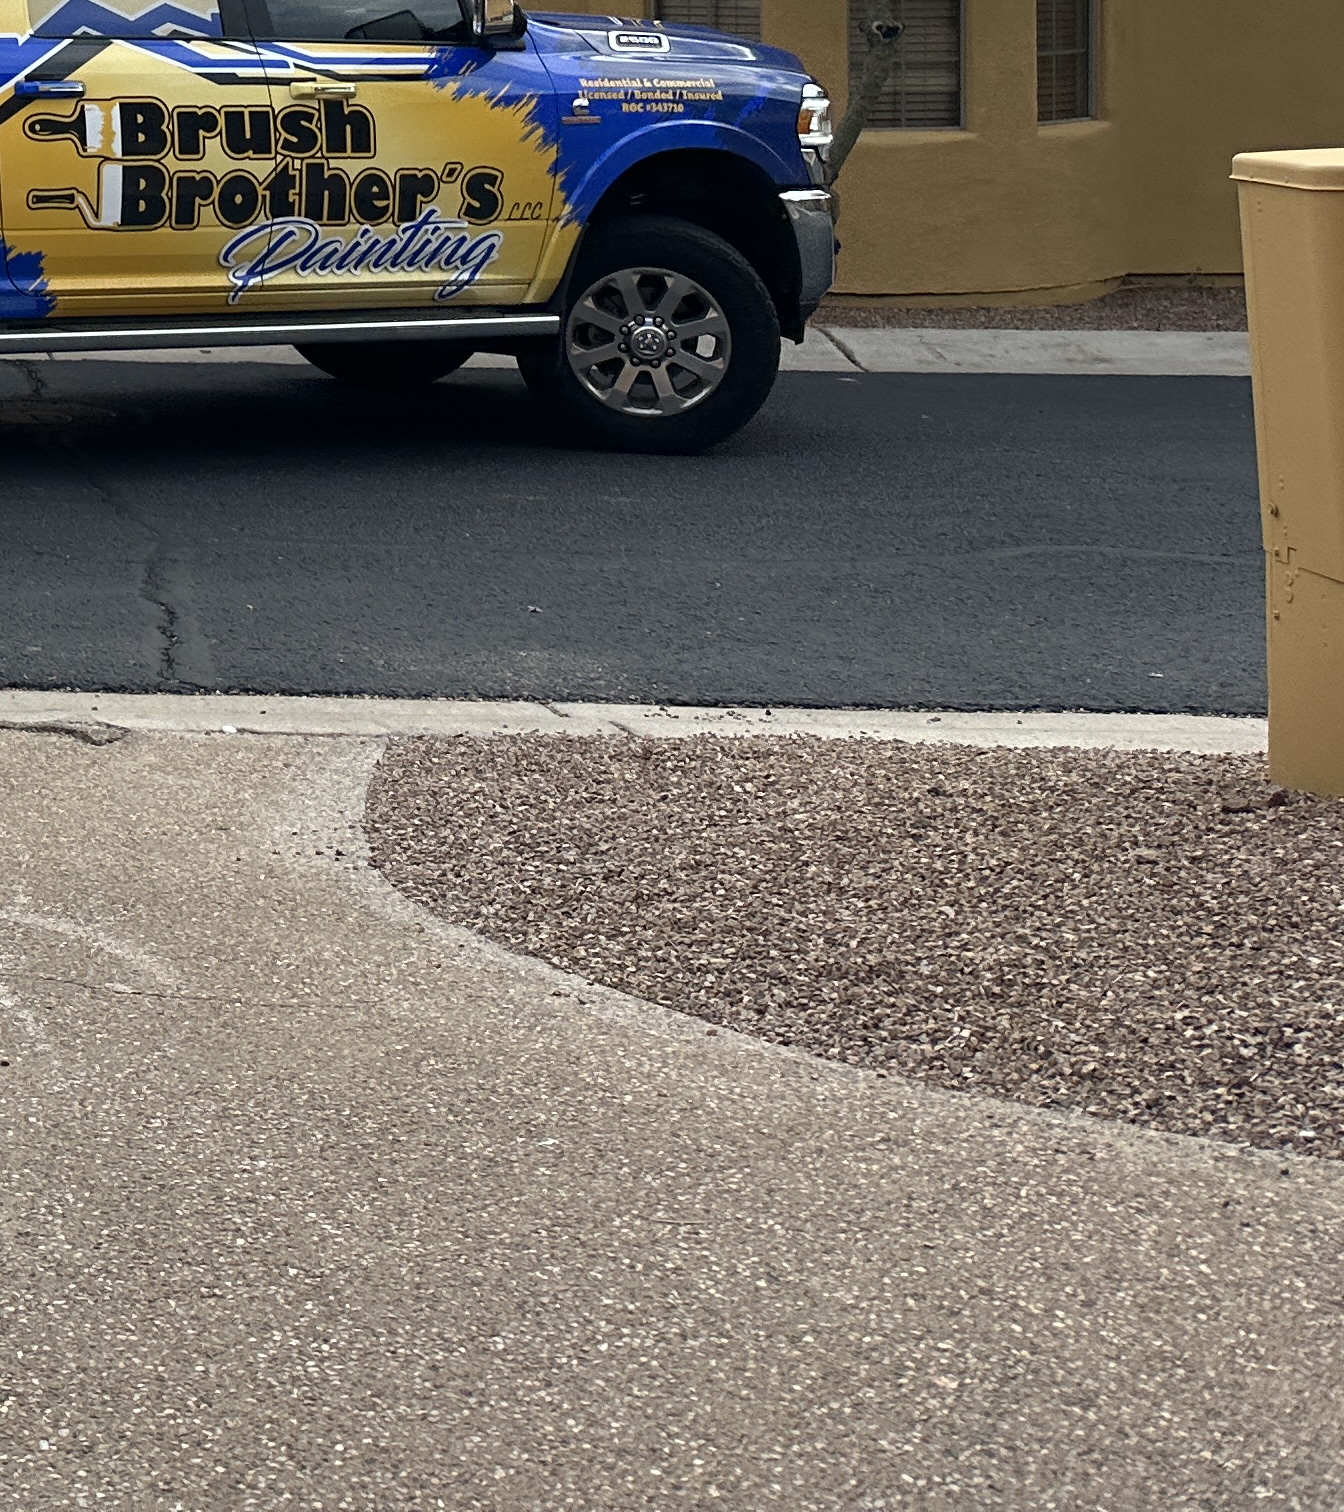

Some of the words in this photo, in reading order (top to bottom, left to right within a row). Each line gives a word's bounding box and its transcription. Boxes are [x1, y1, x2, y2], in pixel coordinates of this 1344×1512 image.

[578, 78, 643, 88] Residential
[643, 79, 652, 88] &
[653, 78, 715, 88] Commercial
[578, 90, 625, 101] Licensed
[634, 90, 673, 101] Bonded
[682, 90, 724, 101] Insured
[622, 103, 643, 113] ROC
[120, 96, 376, 160] Brush
[120, 158, 504, 231] Brother's
[507, 201, 543, 222] LLC
[220, 206, 504, 306] Painting
